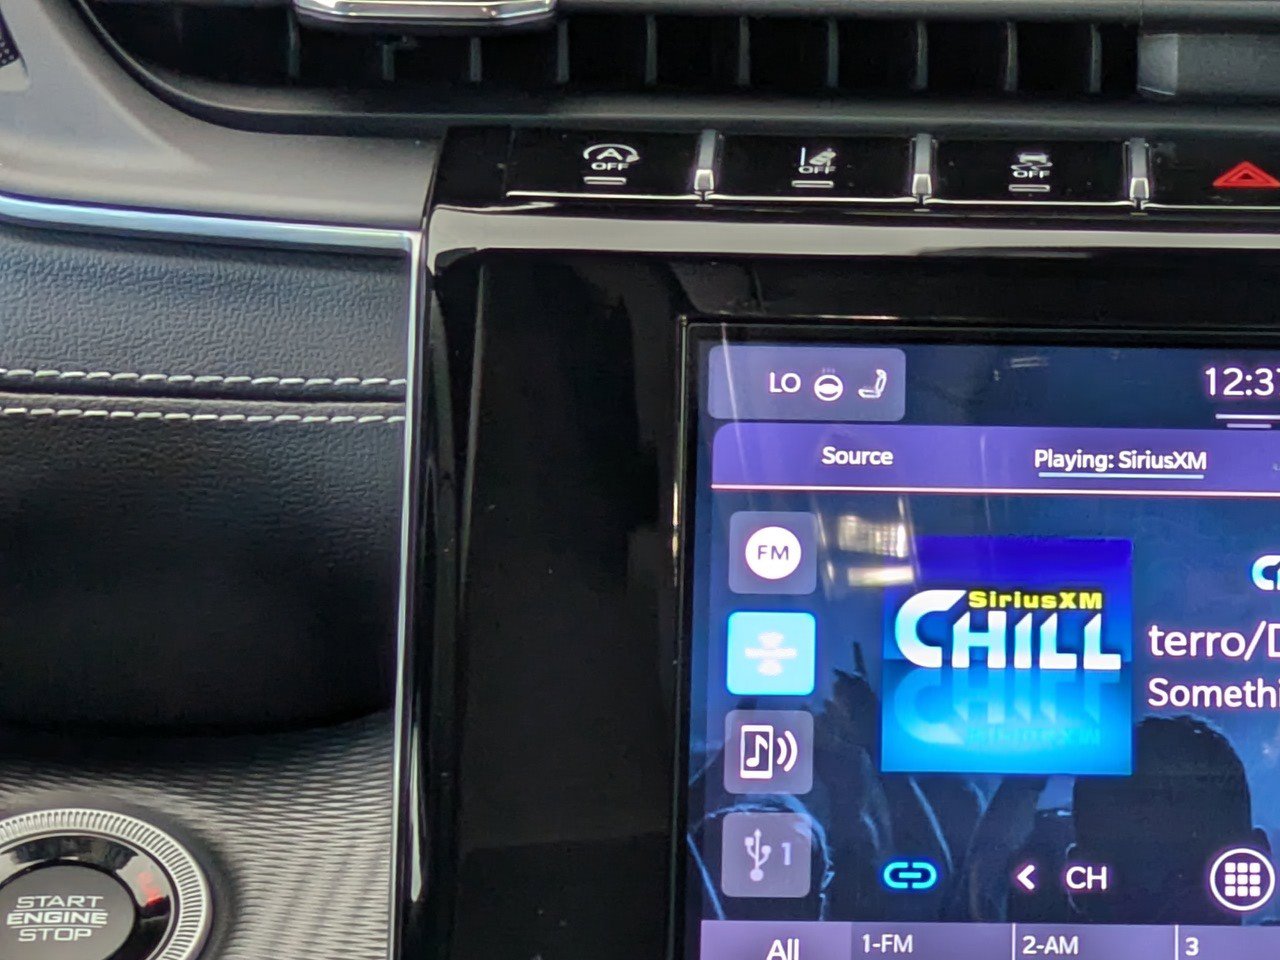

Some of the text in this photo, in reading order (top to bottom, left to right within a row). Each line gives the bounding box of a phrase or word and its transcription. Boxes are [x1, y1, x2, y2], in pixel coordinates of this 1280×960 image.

[591, 162, 629, 171] OFF
[798, 166, 836, 174] OFF
[1012, 170, 1050, 178] OFF
[769, 372, 801, 394] LO
[821, 446, 894, 467] Source
[1034, 449, 1207, 473] Playing: SiriusXM
[757, 544, 790, 562] FM
[968, 590, 1103, 610] SiriusXM
[895, 589, 1122, 670] CHILL
[781, 841, 792, 866] 1
[1066, 866, 1108, 891] CH
[16, 895, 104, 909] START
[6, 911, 109, 926] ENGINE
[18, 927, 93, 942] STOP
[862, 934, 914, 954] 1-FM
[1022, 936, 1080, 955] 2-AM
[1185, 938, 1199, 956] 3
